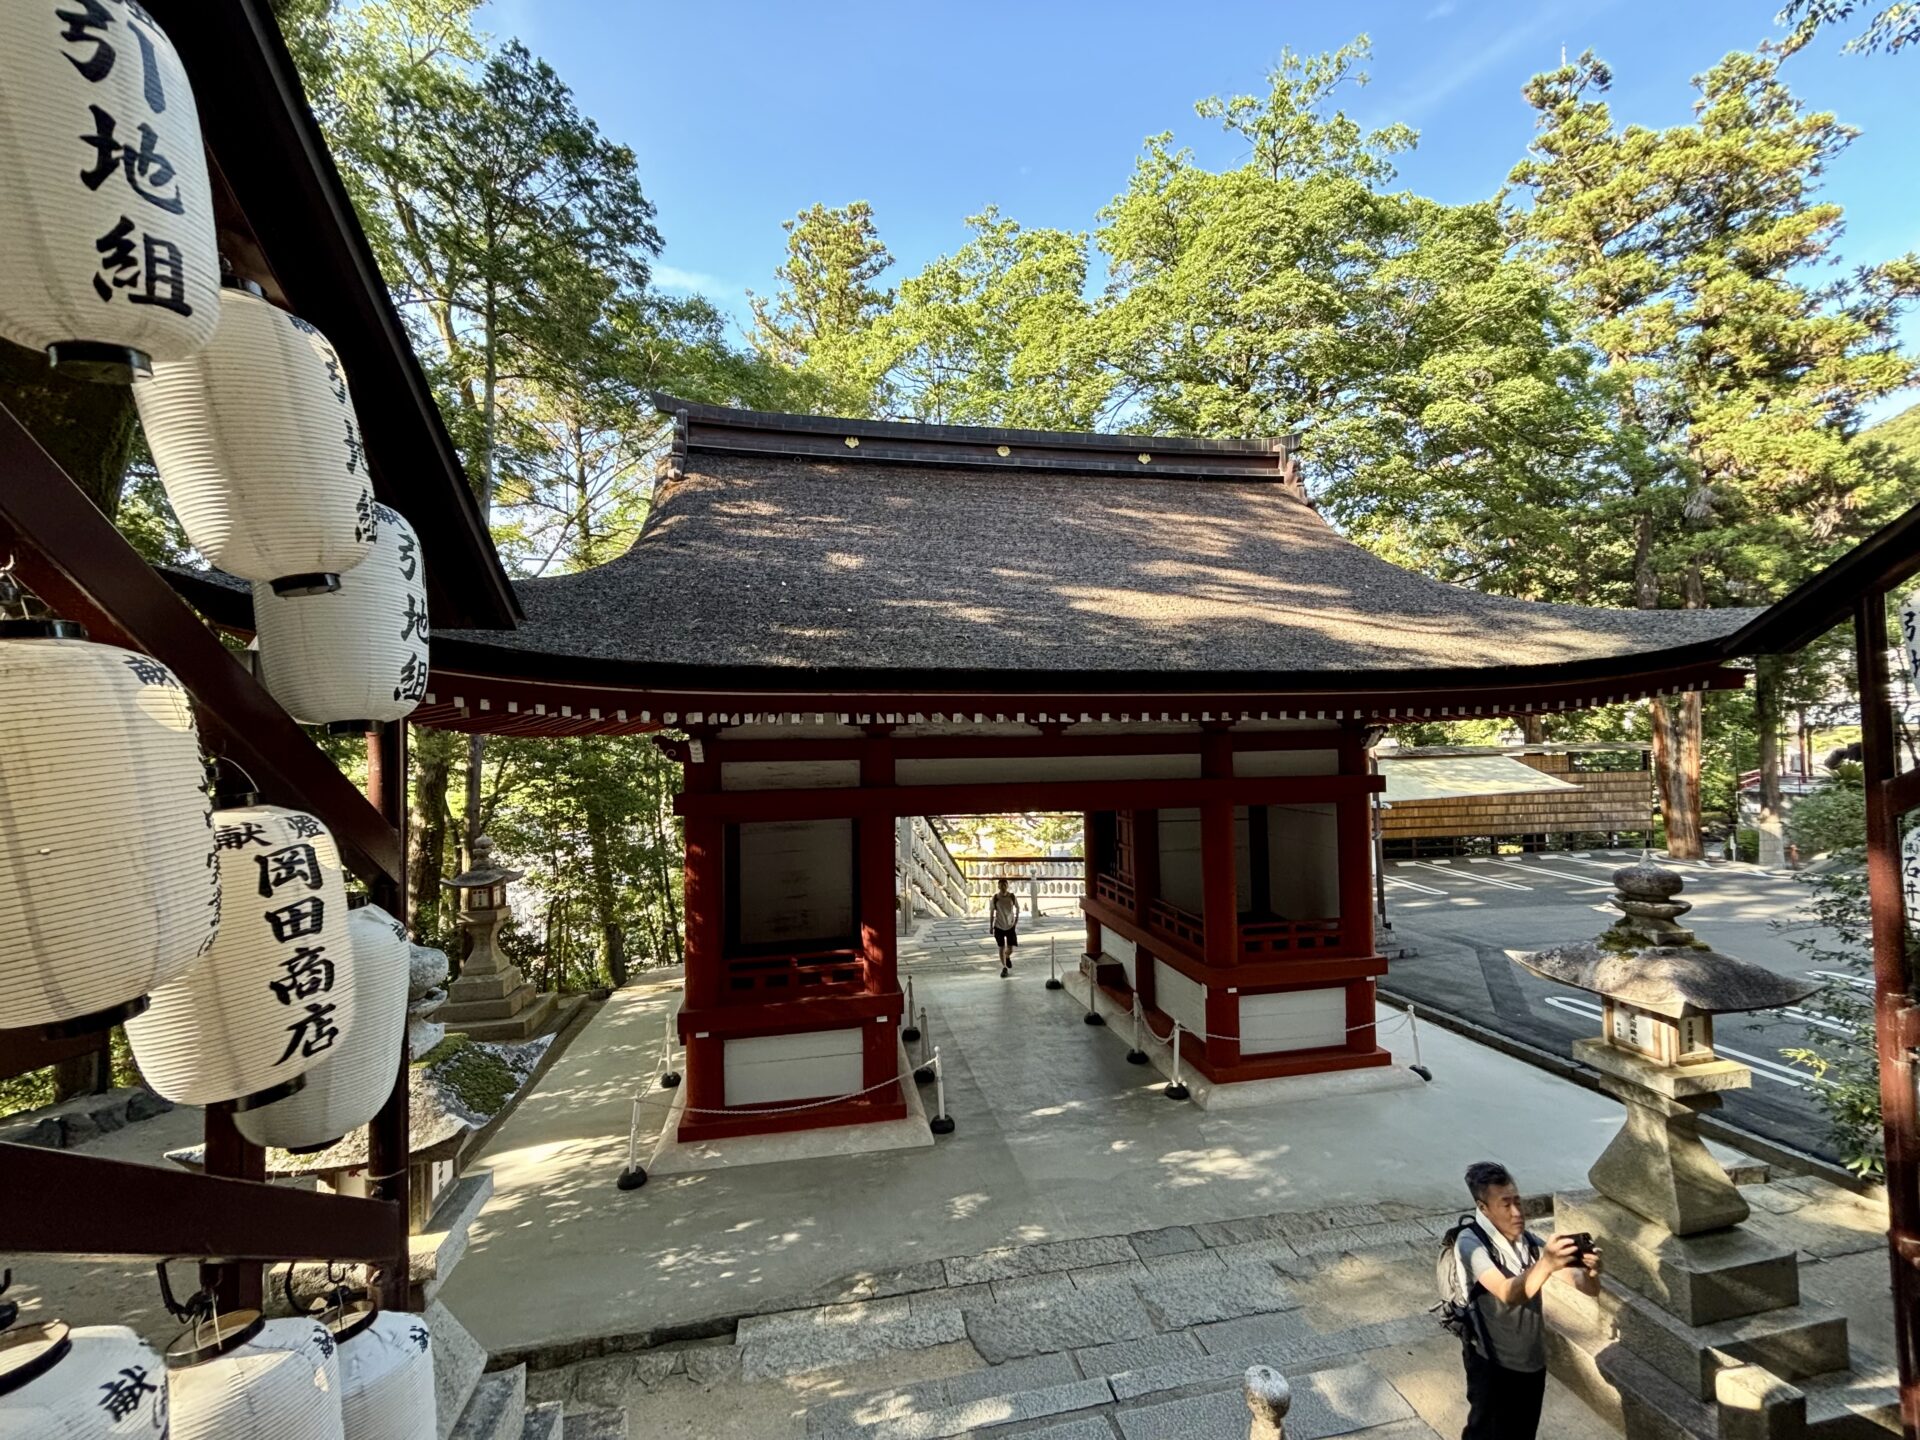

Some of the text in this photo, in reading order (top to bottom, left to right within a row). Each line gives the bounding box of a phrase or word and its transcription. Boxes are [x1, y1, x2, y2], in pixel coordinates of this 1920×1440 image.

[55, 0, 193, 317] 引地組
[254, 843, 340, 1067] 岡田商店
